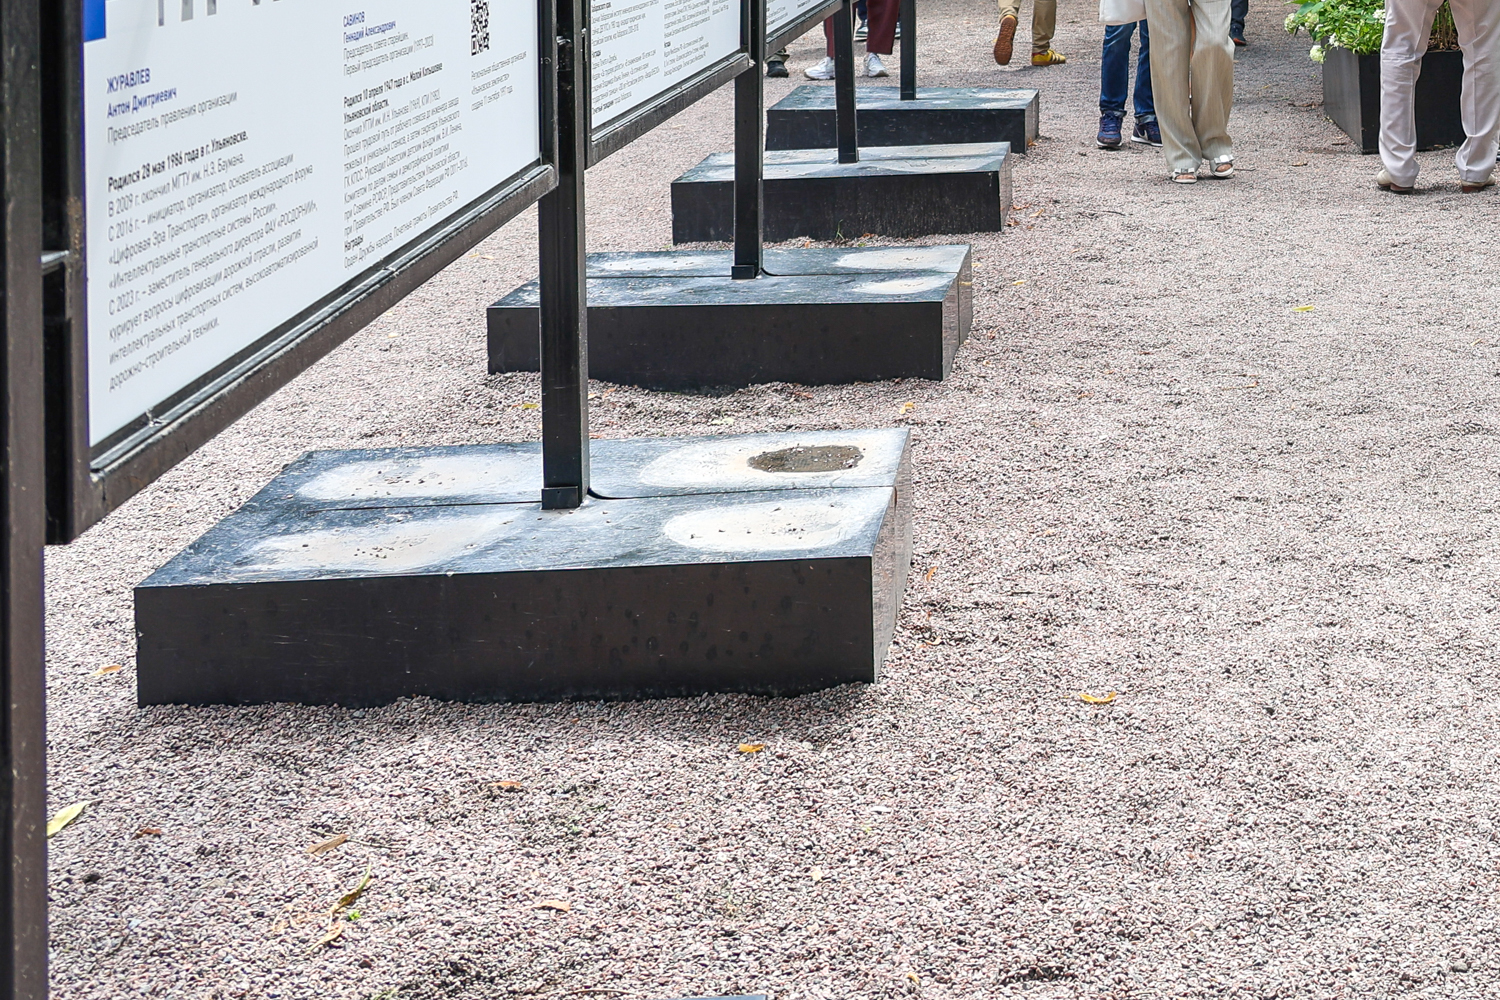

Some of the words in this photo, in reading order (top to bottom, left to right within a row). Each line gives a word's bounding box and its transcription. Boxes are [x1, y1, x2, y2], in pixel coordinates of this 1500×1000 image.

[107, 68, 150, 94] ЖУРАВЛЕВ
[107, 101, 130, 118] Антон
[131, 88, 177, 114] Дмитриевич
[107, 117, 159, 145] Председатель
[160, 104, 197, 127] правления
[197, 92, 237, 115] организации
[108, 170, 140, 193] Родился
[152, 160, 166, 176] мая
[167, 151, 183, 170] 1986
[184, 148, 199, 163] года
[211, 131, 248, 153] Ульяновске.
